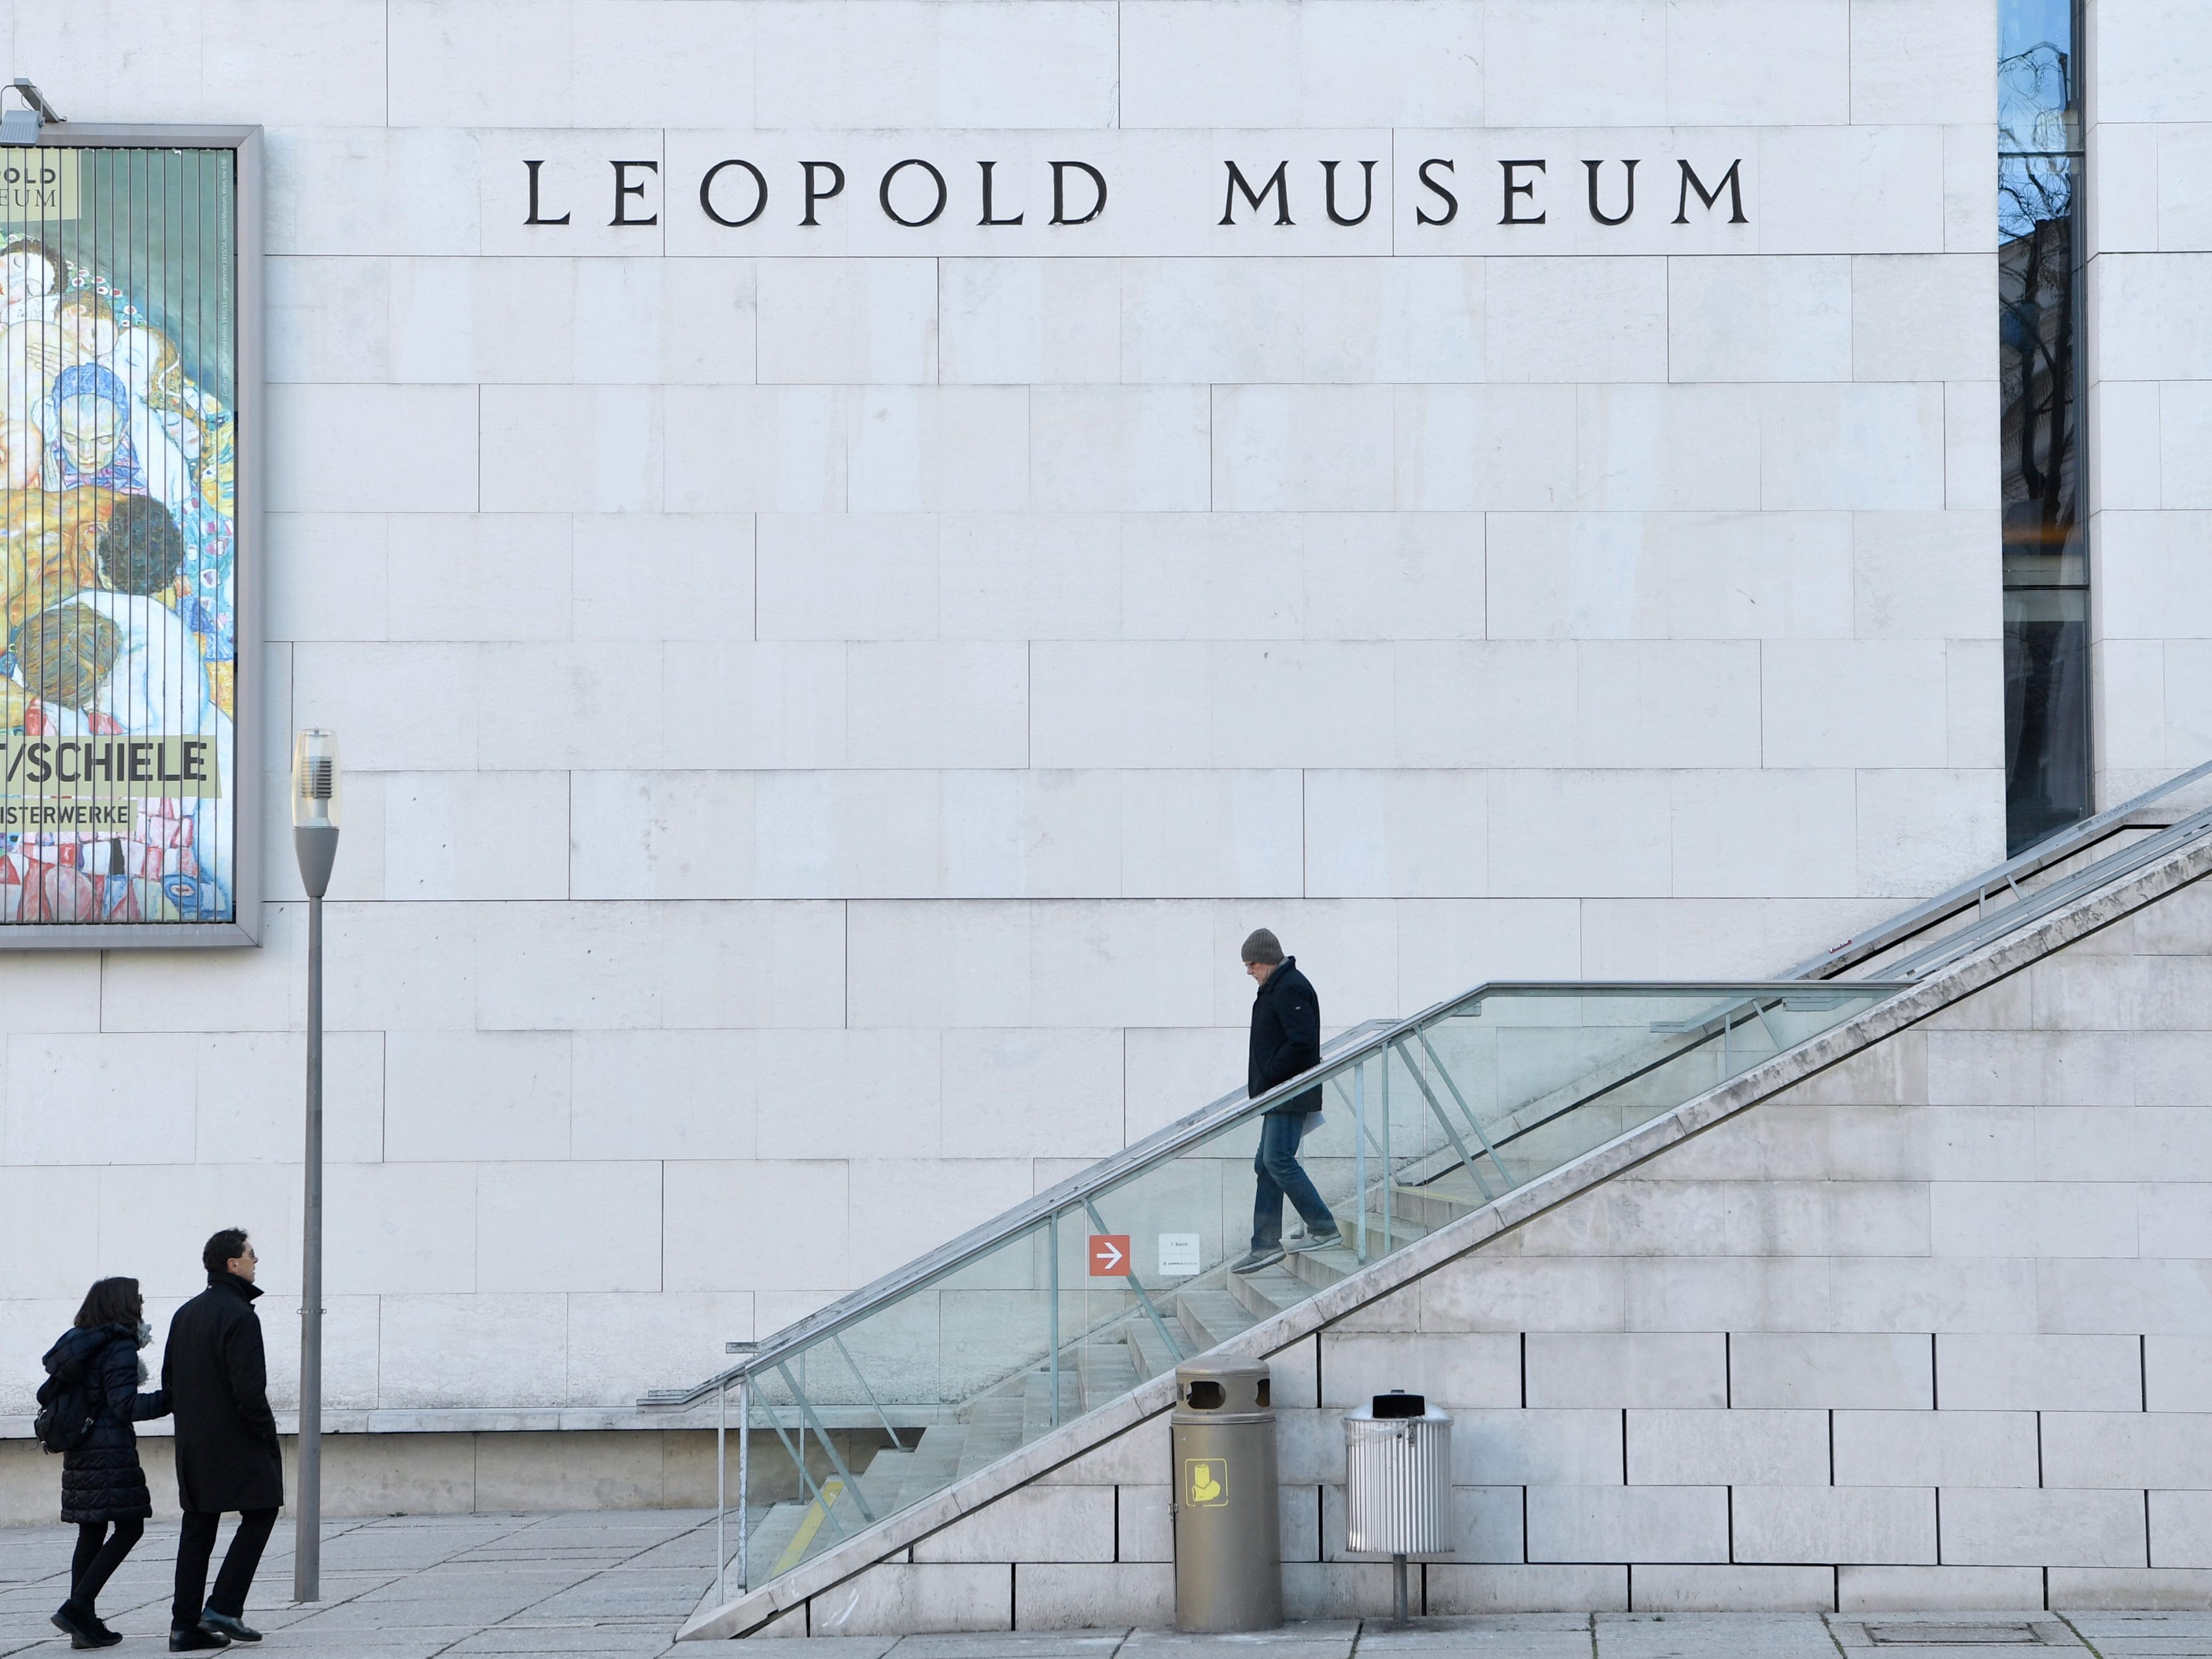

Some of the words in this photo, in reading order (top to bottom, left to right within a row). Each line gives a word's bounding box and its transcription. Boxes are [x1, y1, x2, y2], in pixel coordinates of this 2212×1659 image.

[0, 167, 56, 184] OLD
[523, 160, 1107, 228] LEOPOLD
[1218, 158, 1748, 226] MUSEUM
[0, 806, 128, 824] ISTERWERKE
